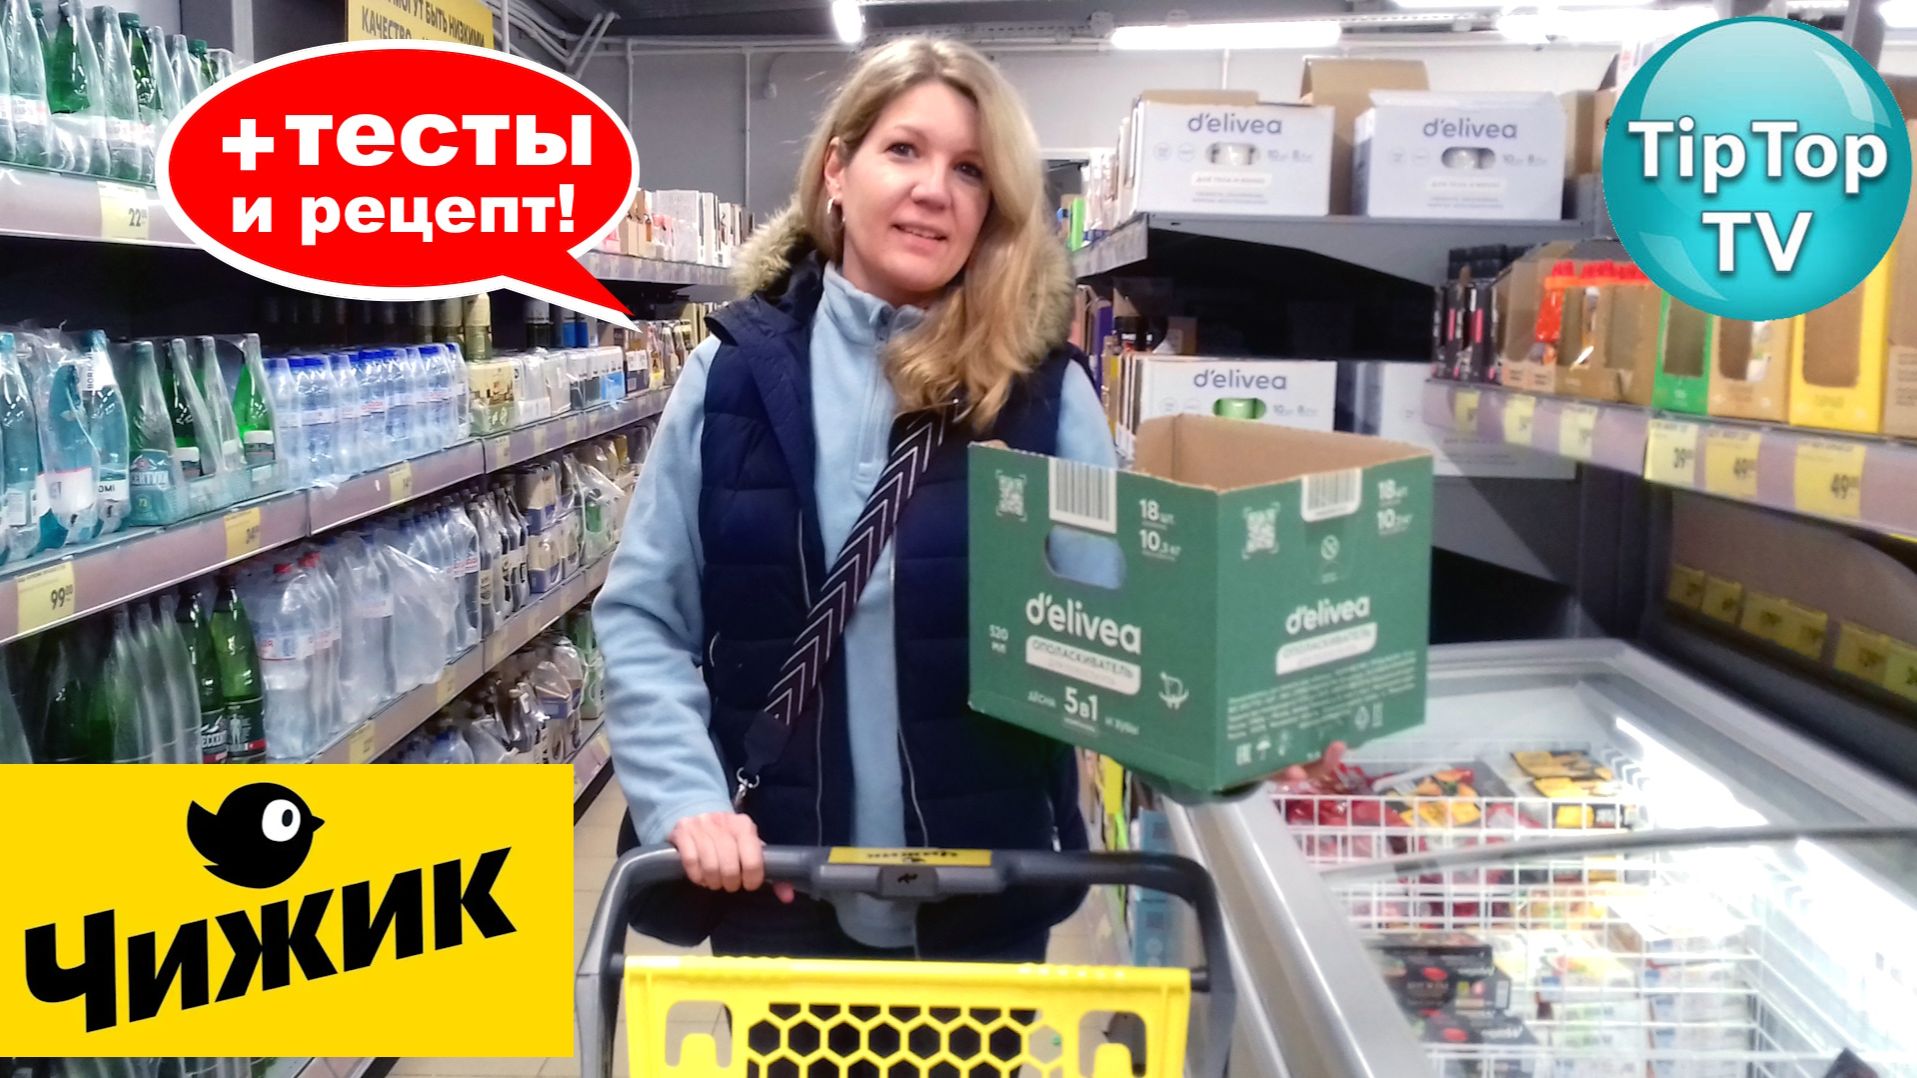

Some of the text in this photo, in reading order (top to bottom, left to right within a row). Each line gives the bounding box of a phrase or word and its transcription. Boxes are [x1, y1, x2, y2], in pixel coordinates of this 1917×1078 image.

[425, 1, 448, 33] БЫТЬ
[1187, 112, 1283, 135] d'elivea
[1422, 117, 1518, 139] d'elivea
[1193, 369, 1288, 390] d'elivea
[1139, 499, 1160, 521] 18
[51, 587, 65, 610] 99
[1025, 592, 1142, 655] d'elivea
[1286, 596, 1371, 634] d'elivea
